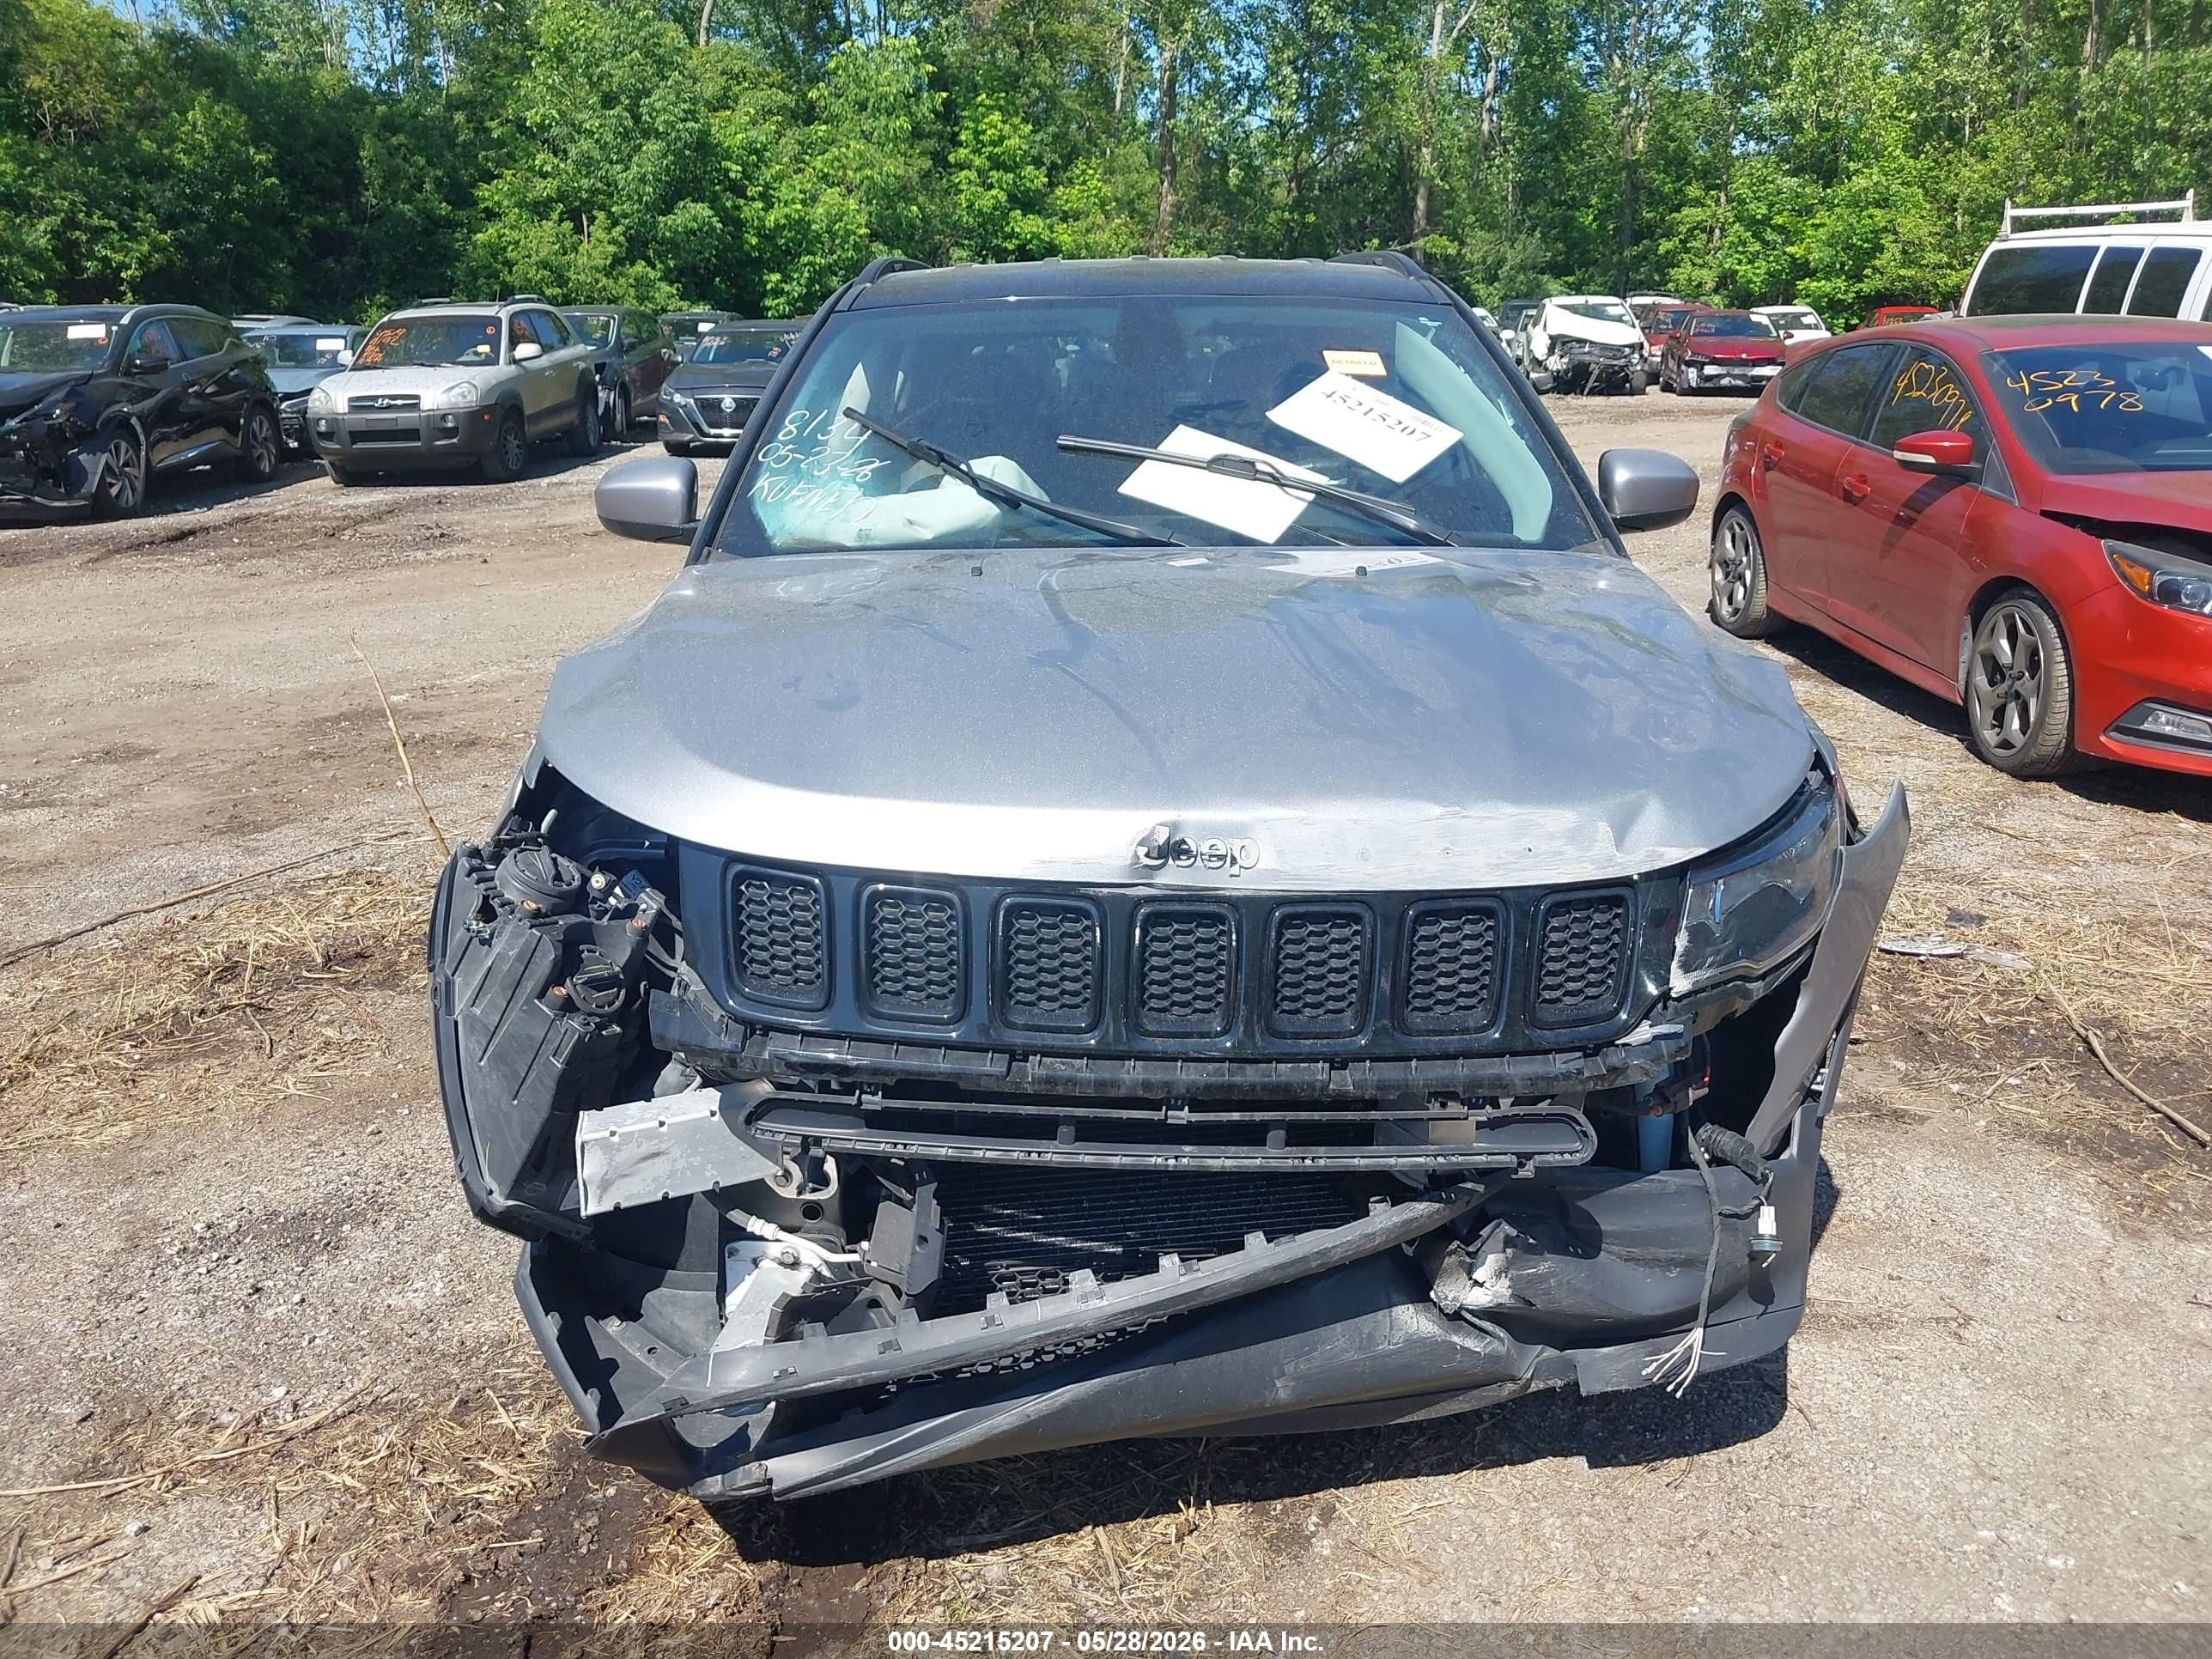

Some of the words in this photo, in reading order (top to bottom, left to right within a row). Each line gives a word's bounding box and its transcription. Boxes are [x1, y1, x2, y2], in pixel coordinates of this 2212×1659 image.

[2006, 370, 2116, 396] 4523
[2023, 390, 2143, 412] 0978
[1322, 390, 1432, 441] 45215207
[1133, 824, 1261, 878] Jeep
